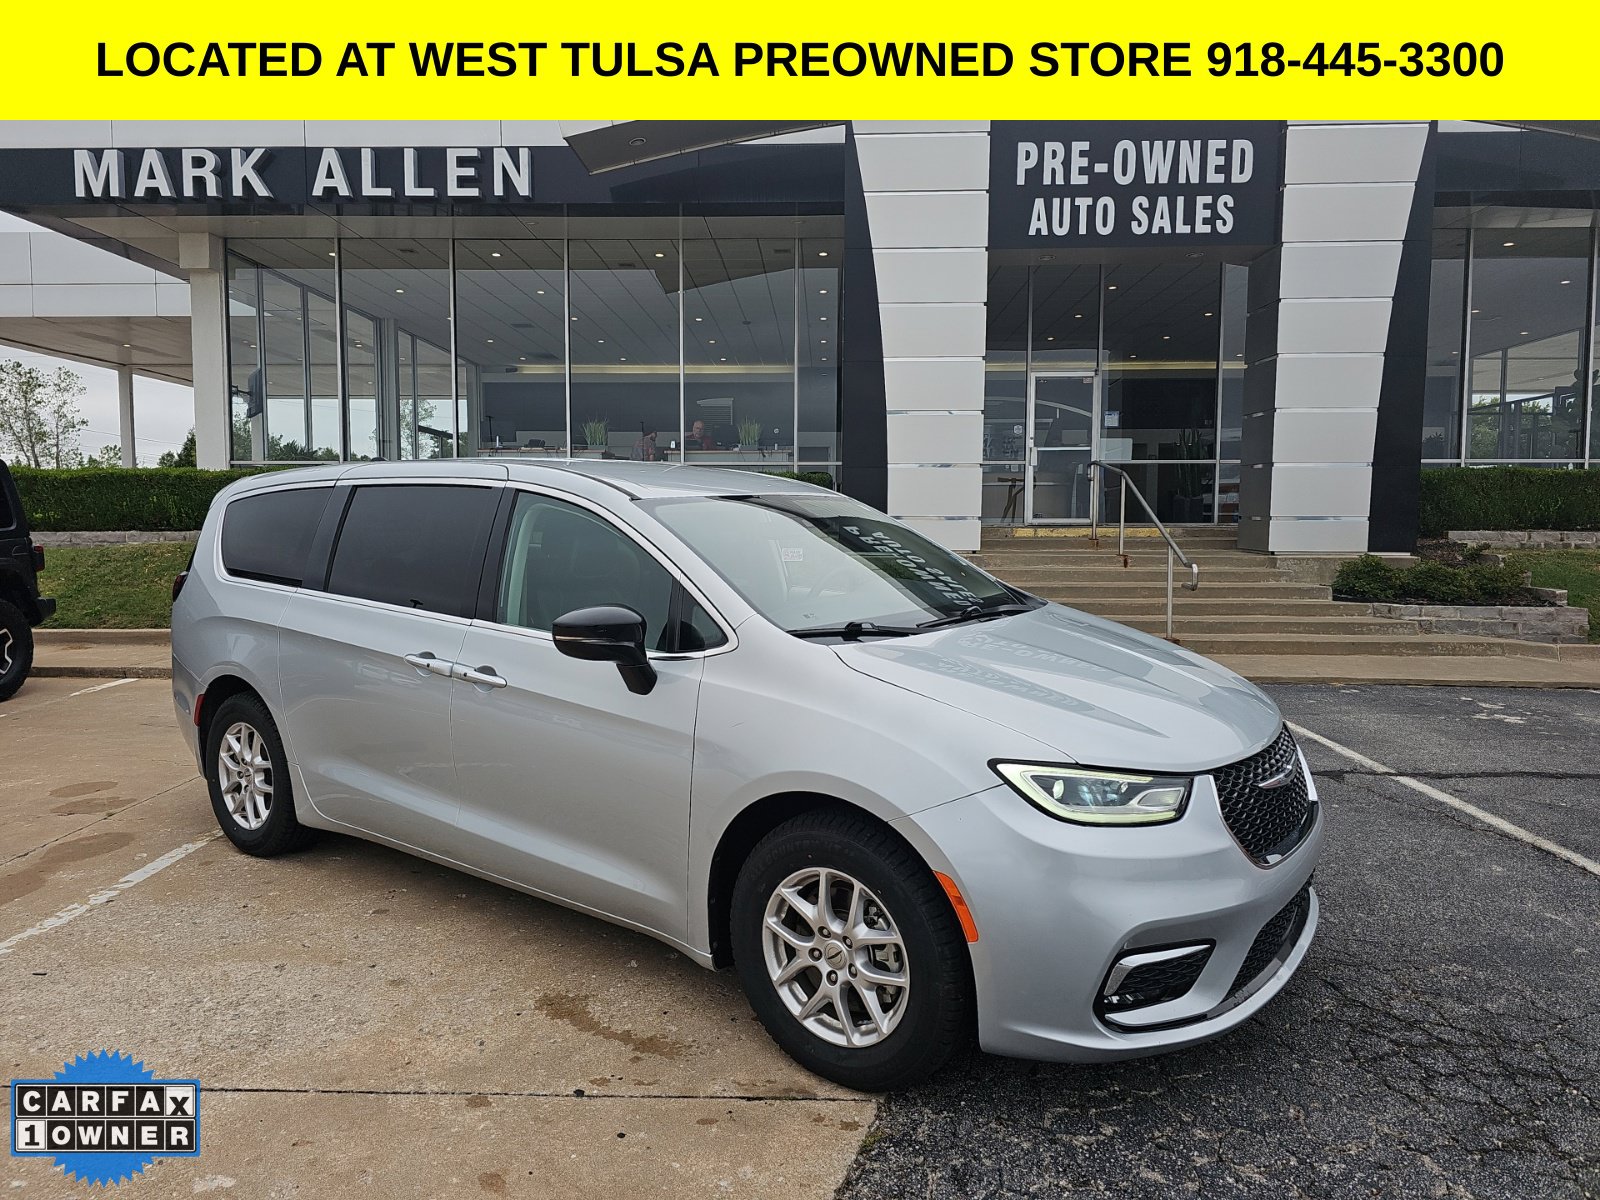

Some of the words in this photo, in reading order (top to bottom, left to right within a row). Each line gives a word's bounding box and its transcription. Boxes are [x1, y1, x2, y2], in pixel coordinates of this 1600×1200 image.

[73, 147, 274, 199] MARK
[312, 146, 533, 198] ALLEN
[1016, 139, 1254, 186] PRE-OWNED
[1028, 196, 1116, 236] AUTO
[1130, 194, 1235, 235] SALES
